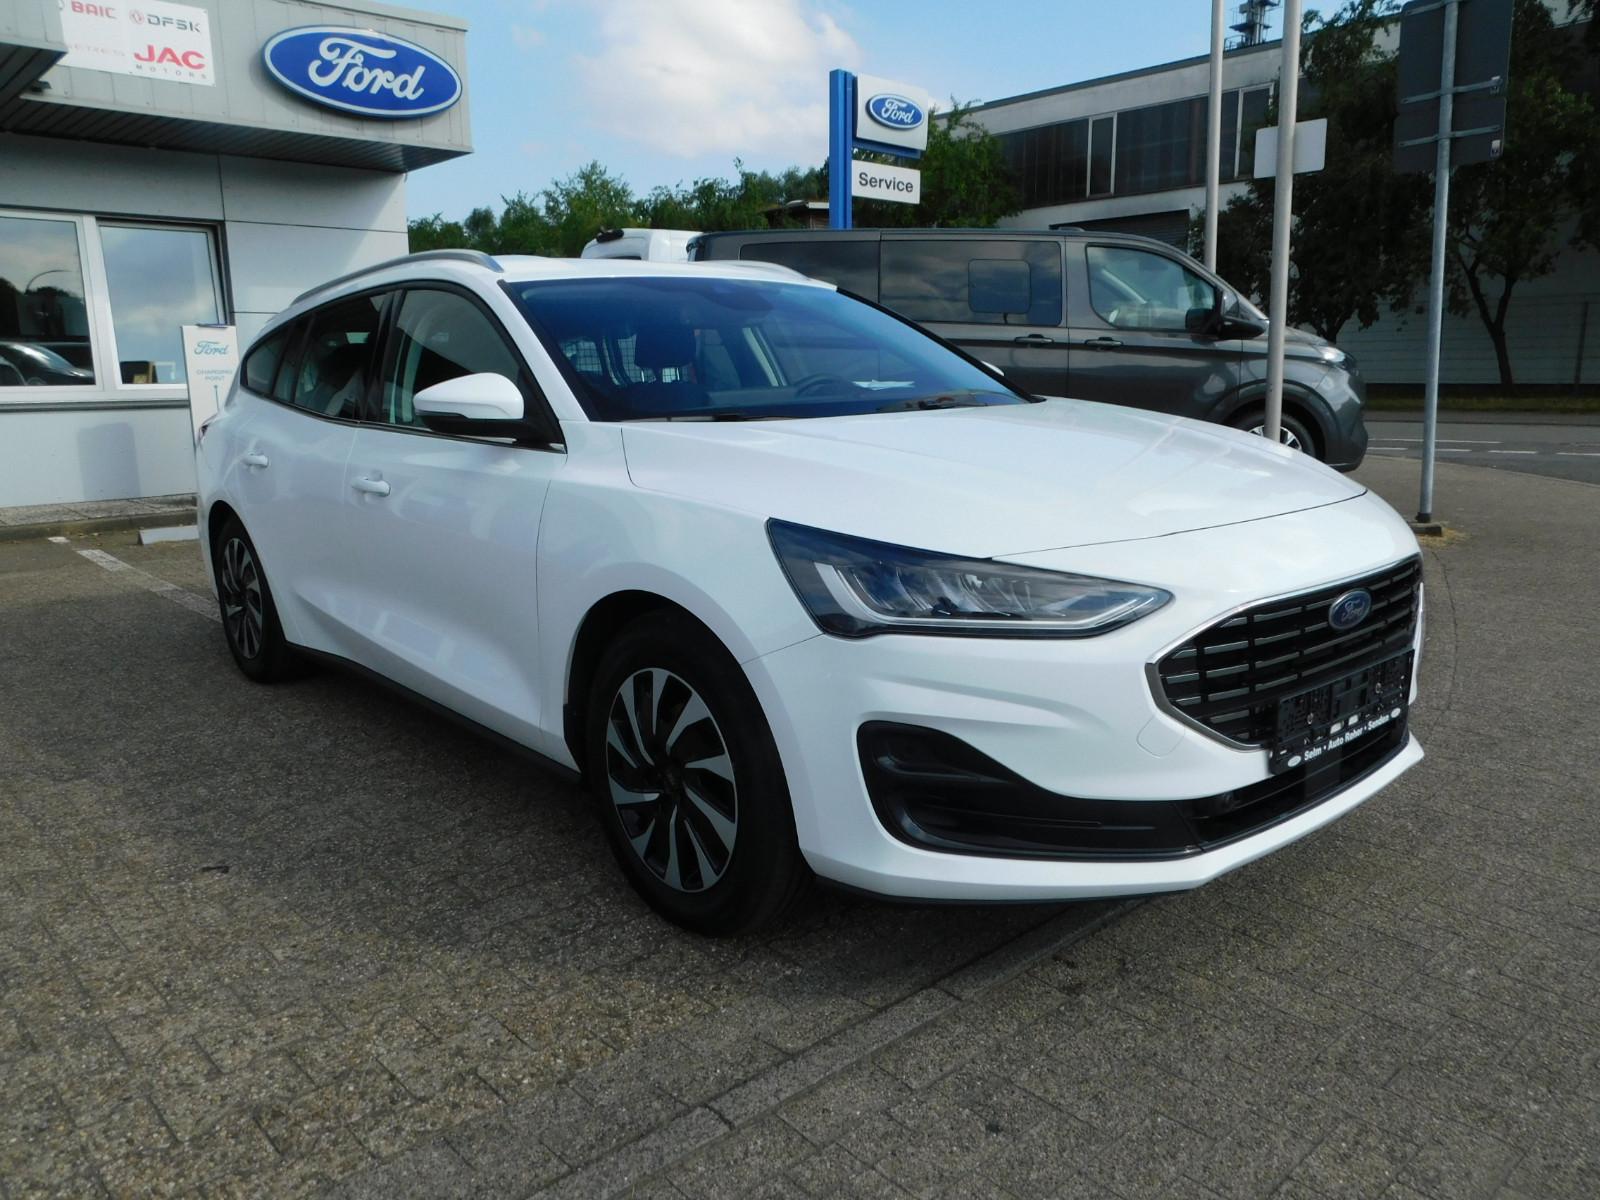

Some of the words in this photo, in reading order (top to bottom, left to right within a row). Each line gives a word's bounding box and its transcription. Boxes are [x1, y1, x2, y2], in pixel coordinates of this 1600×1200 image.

[71, 1, 117, 19] BAIC
[147, 14, 201, 33] DFSK
[134, 44, 206, 70] JAC
[135, 63, 207, 80] MOTORS
[308, 36, 425, 101] Ford
[881, 99, 915, 123] Ford
[858, 172, 914, 193] Service
[194, 340, 229, 355] Ford
[1340, 598, 1366, 622] Ford
[1328, 736, 1344, 751] Auto
